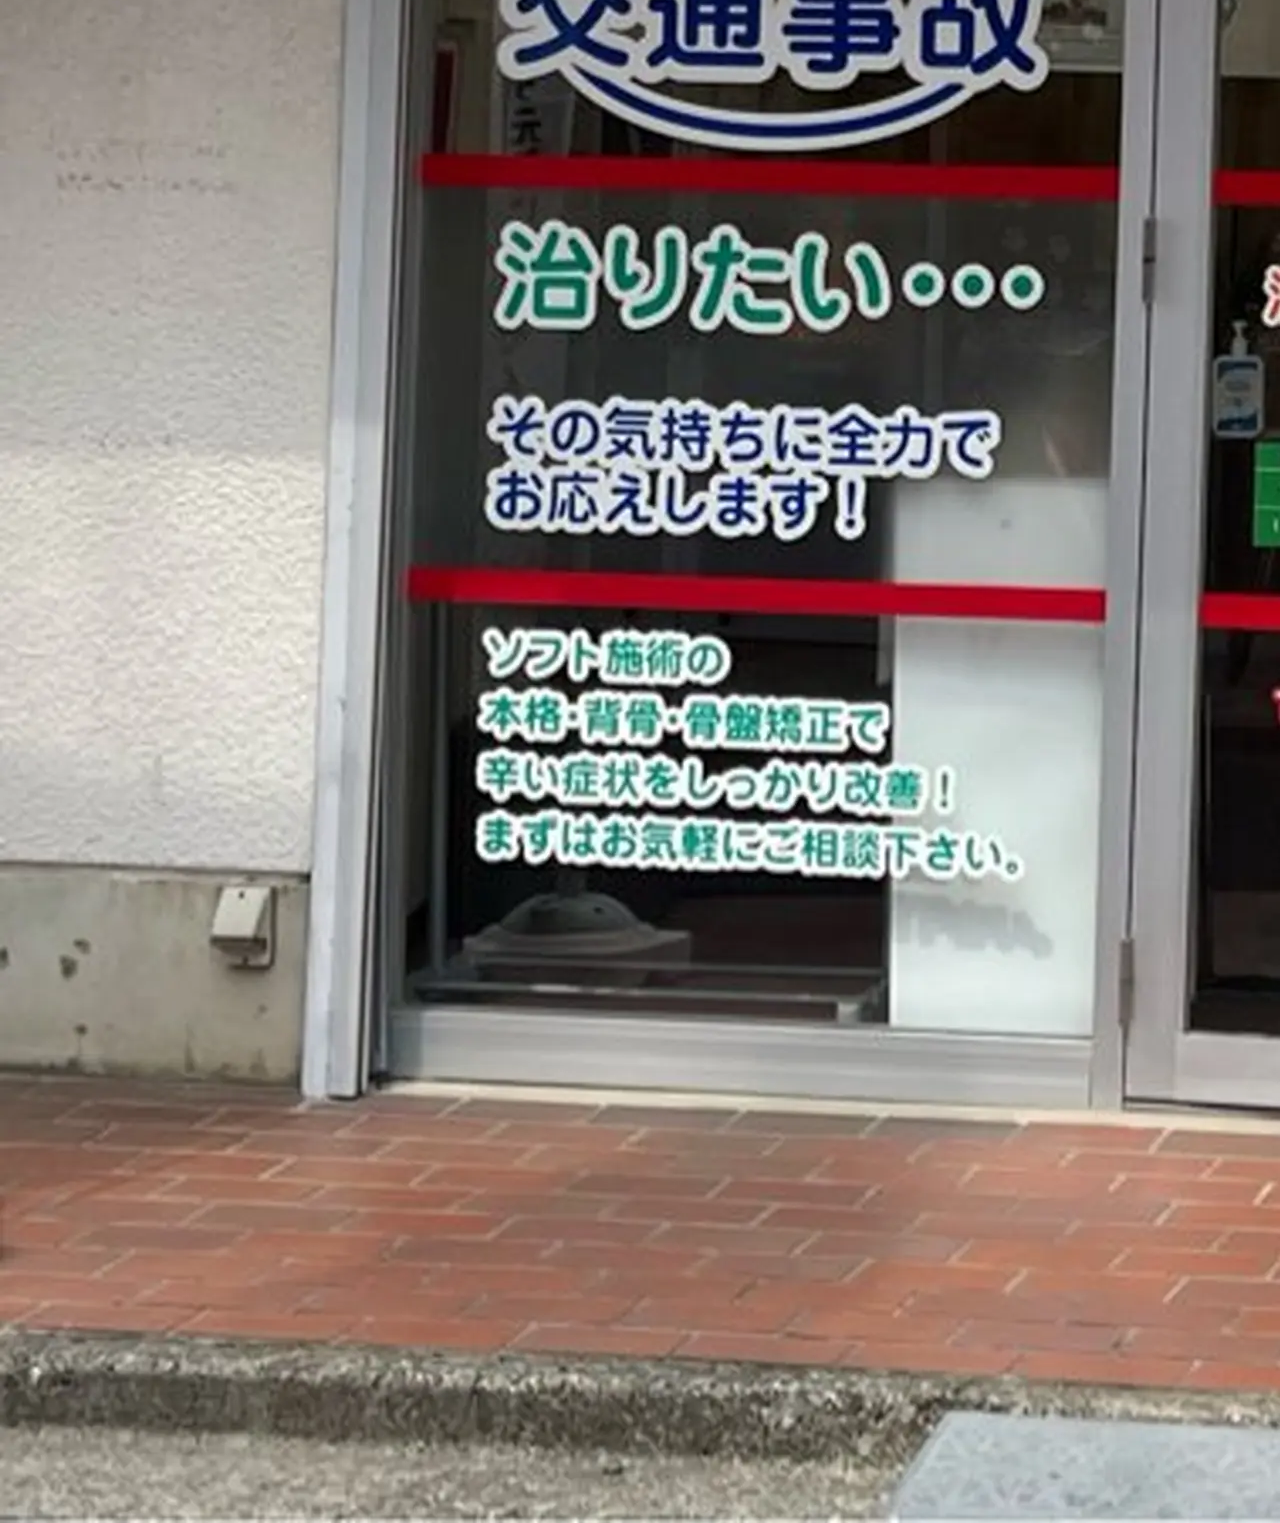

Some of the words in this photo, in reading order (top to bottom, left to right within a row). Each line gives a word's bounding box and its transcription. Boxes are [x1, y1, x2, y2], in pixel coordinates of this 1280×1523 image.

[490, 400, 998, 478] その気持ちに全力で
[483, 630, 730, 684] ソフト施術の
[480, 689, 888, 754] 本格・背骨・骨盤矯正で
[477, 813, 1026, 878] まずはお気軽にご相談下さい。
